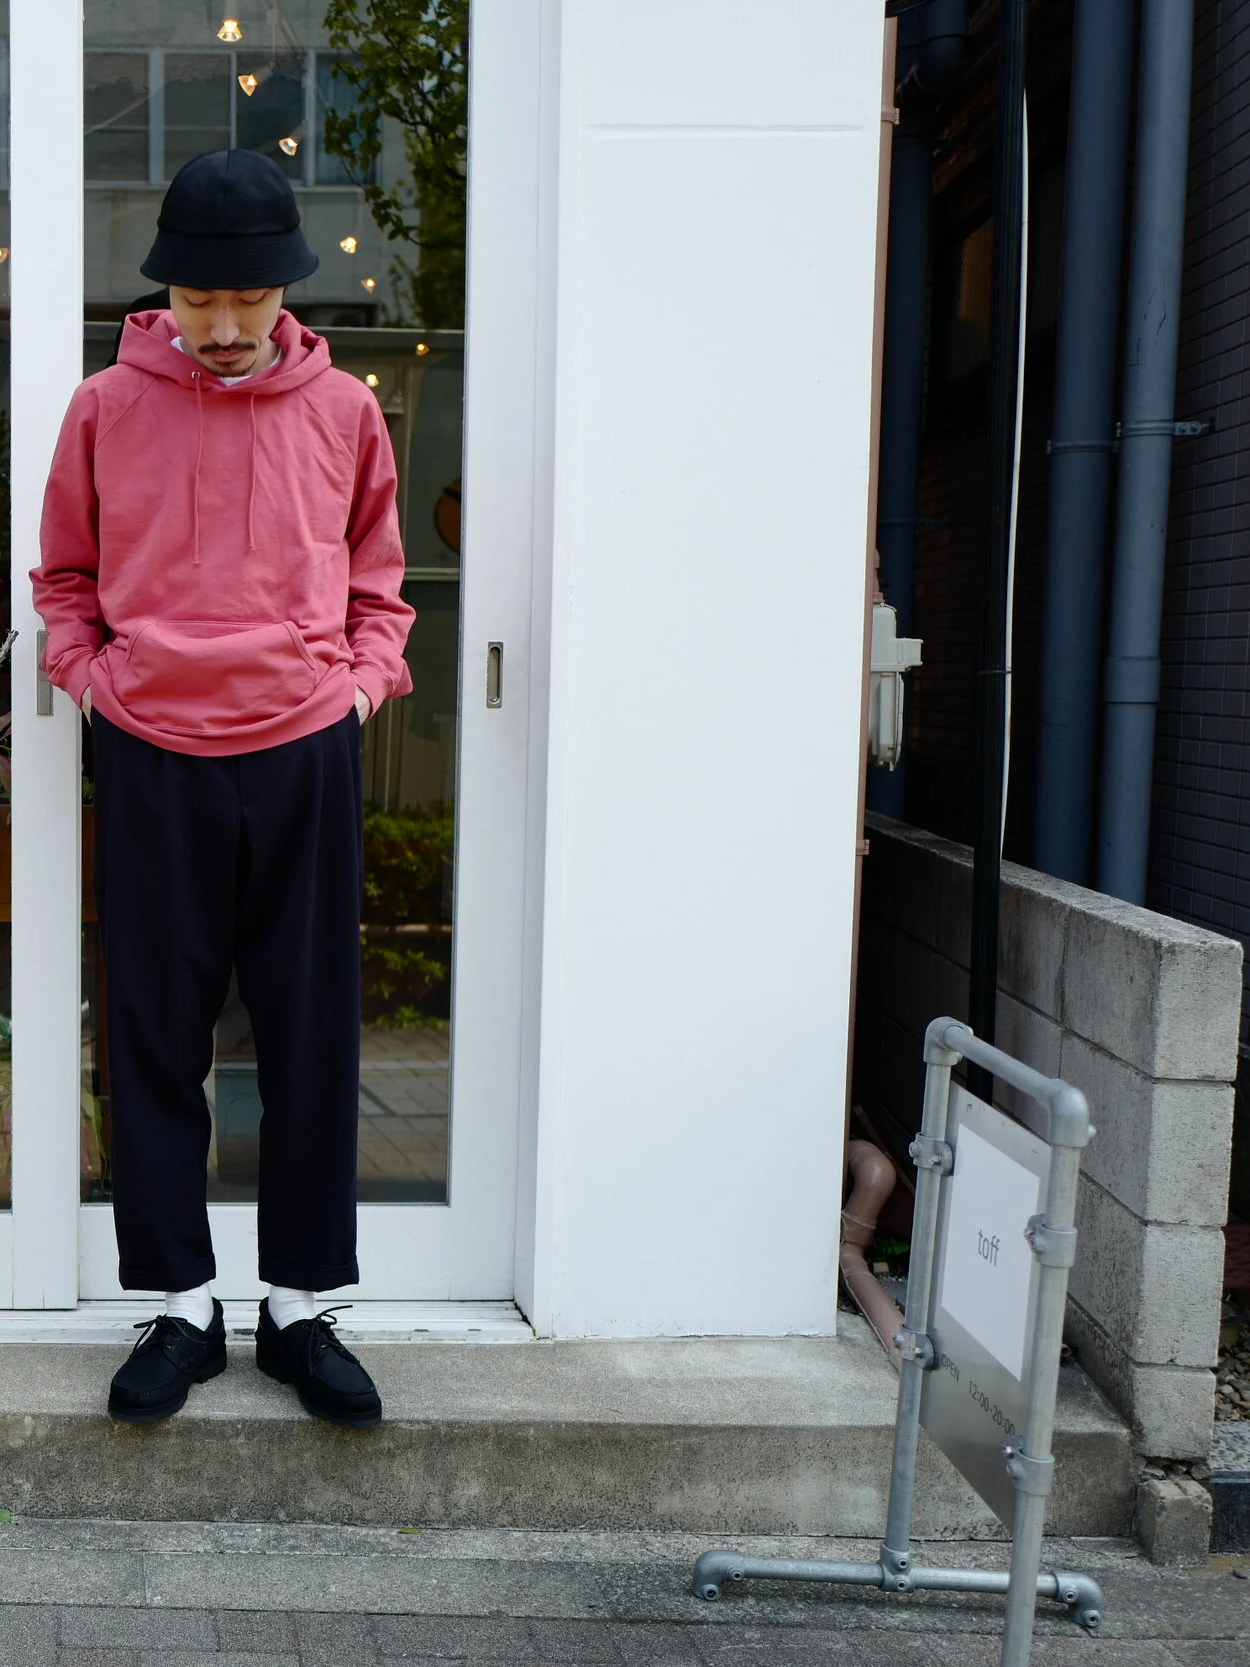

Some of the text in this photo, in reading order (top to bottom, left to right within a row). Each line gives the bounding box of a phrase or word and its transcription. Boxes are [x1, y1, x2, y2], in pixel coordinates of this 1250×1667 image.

[978, 1229, 1000, 1267] toff
[941, 1353, 1015, 1436] OPEN 12:00-20:00
